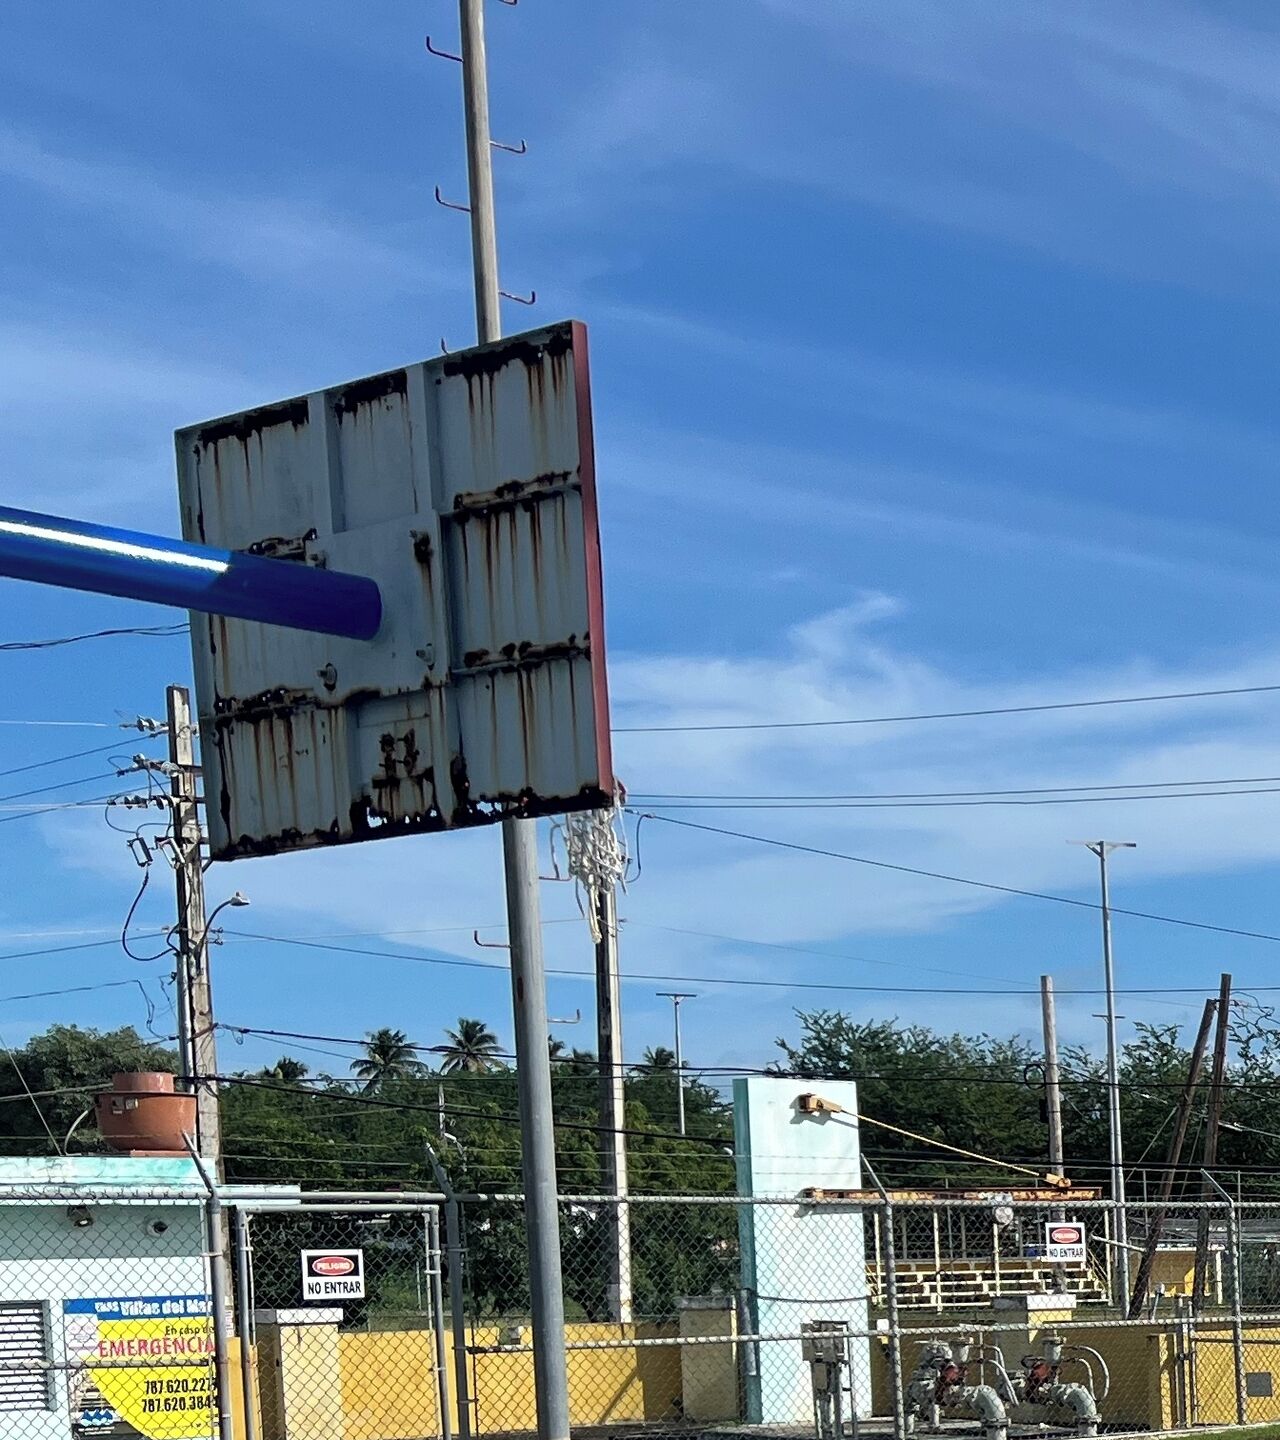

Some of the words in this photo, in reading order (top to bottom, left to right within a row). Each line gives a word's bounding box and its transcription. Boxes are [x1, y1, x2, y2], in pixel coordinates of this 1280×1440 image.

[1049, 1248, 1059, 1258] NO
[1060, 1247, 1084, 1258] ENTRAR
[308, 1281, 322, 1295] NO
[324, 1281, 362, 1295] ENTRAR
[119, 1301, 161, 1316] Villas
[162, 1299, 185, 1314] del
[165, 1325, 178, 1336] En
